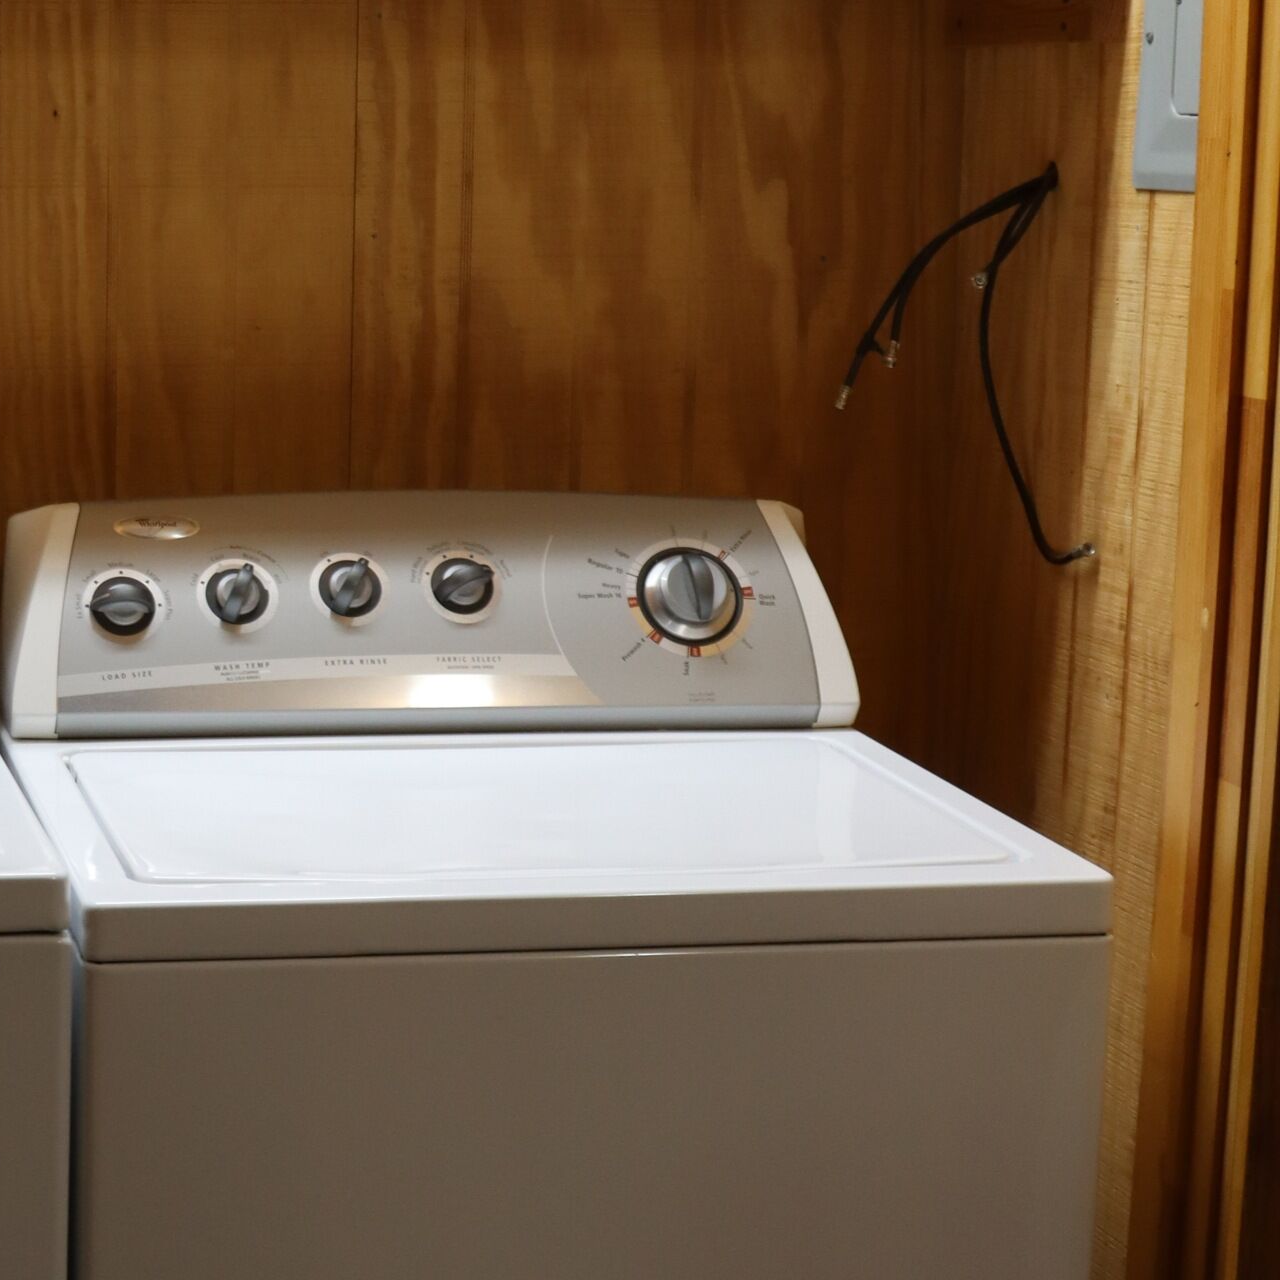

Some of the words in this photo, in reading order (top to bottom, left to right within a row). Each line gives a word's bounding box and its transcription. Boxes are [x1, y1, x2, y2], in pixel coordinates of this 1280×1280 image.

[214, 663, 241, 672] WASH
[245, 661, 270, 669] TEMP
[324, 659, 355, 667] EXTRA
[359, 657, 388, 665] RINSE
[101, 672, 127, 681] LOAD
[132, 670, 153, 678] SIZE
